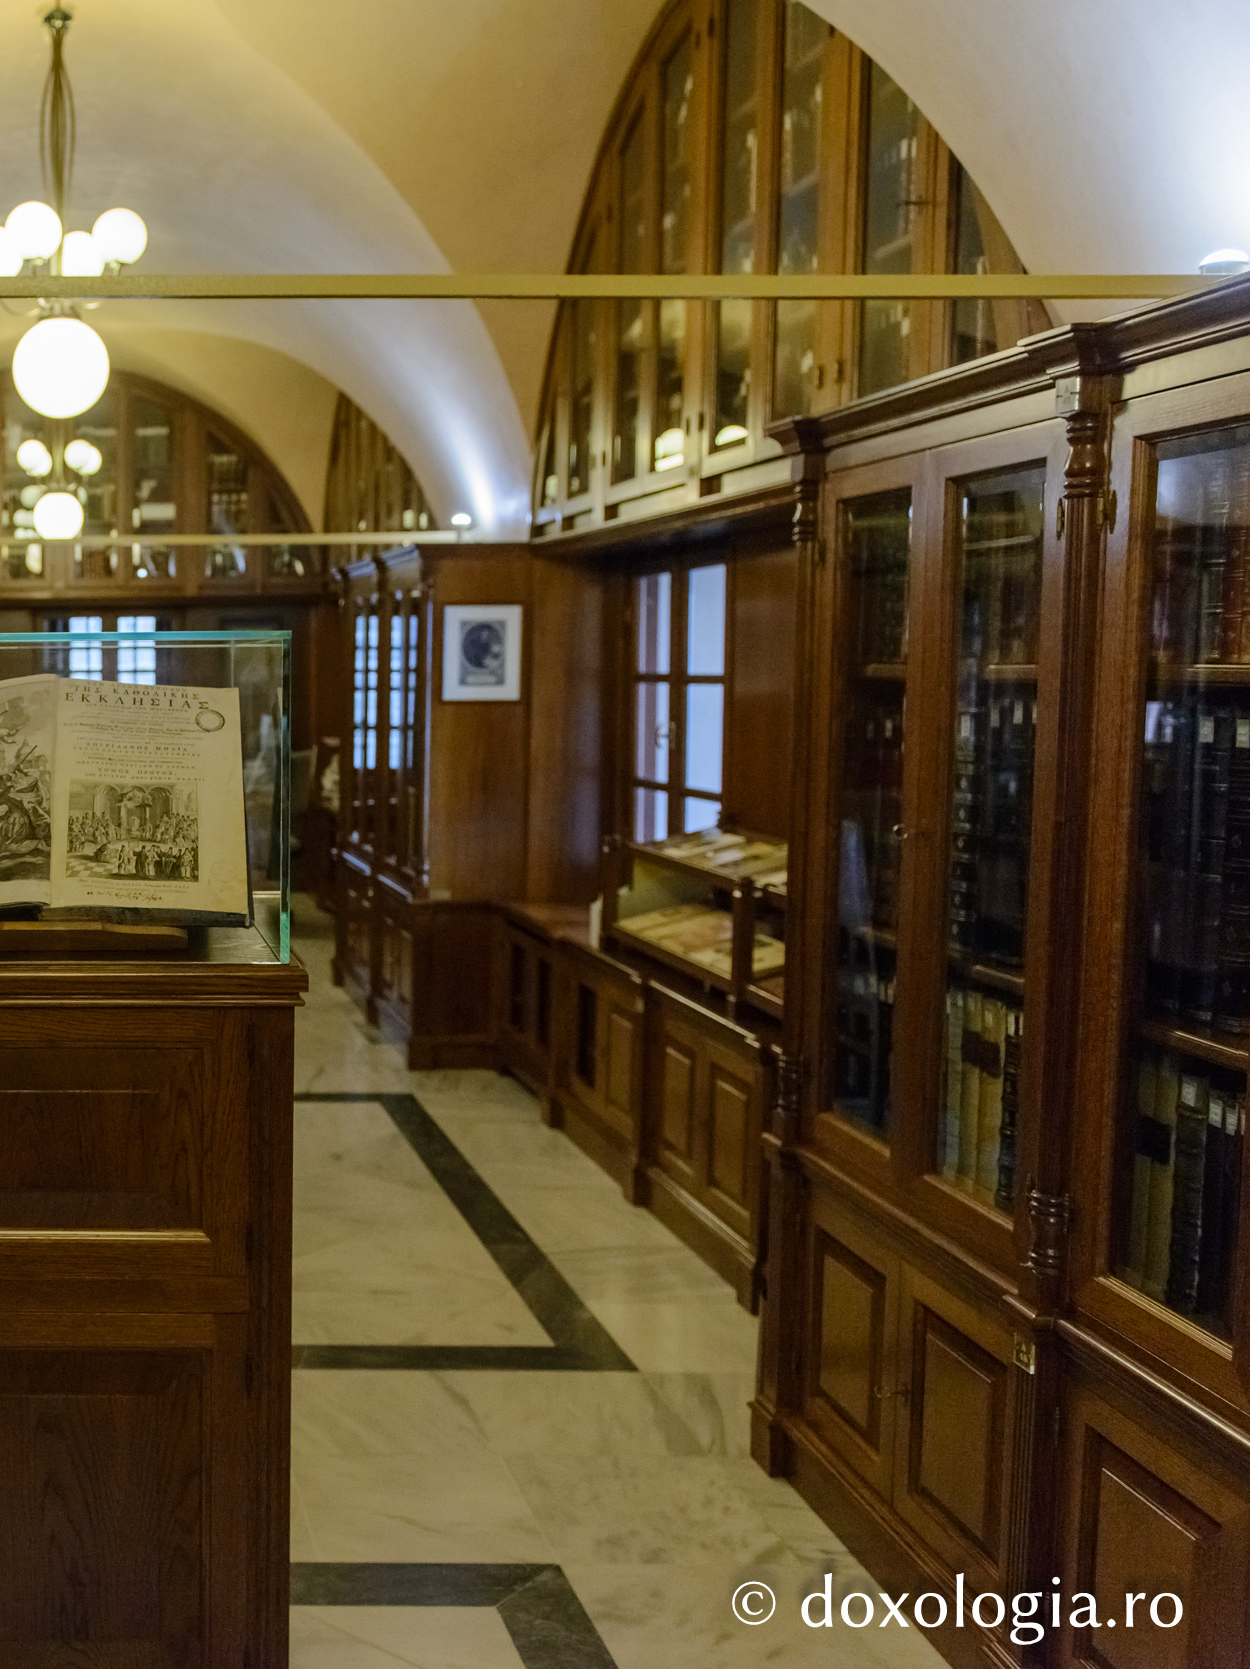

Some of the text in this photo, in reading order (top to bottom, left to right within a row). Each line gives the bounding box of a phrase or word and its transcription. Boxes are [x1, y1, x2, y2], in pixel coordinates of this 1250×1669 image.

[75, 685, 200, 700] ΤΗΣ ΚΑΘΟΛΙΚΗΣ
[65, 692, 210, 710] ΕΚΚΛΗΣΙΑΣ
